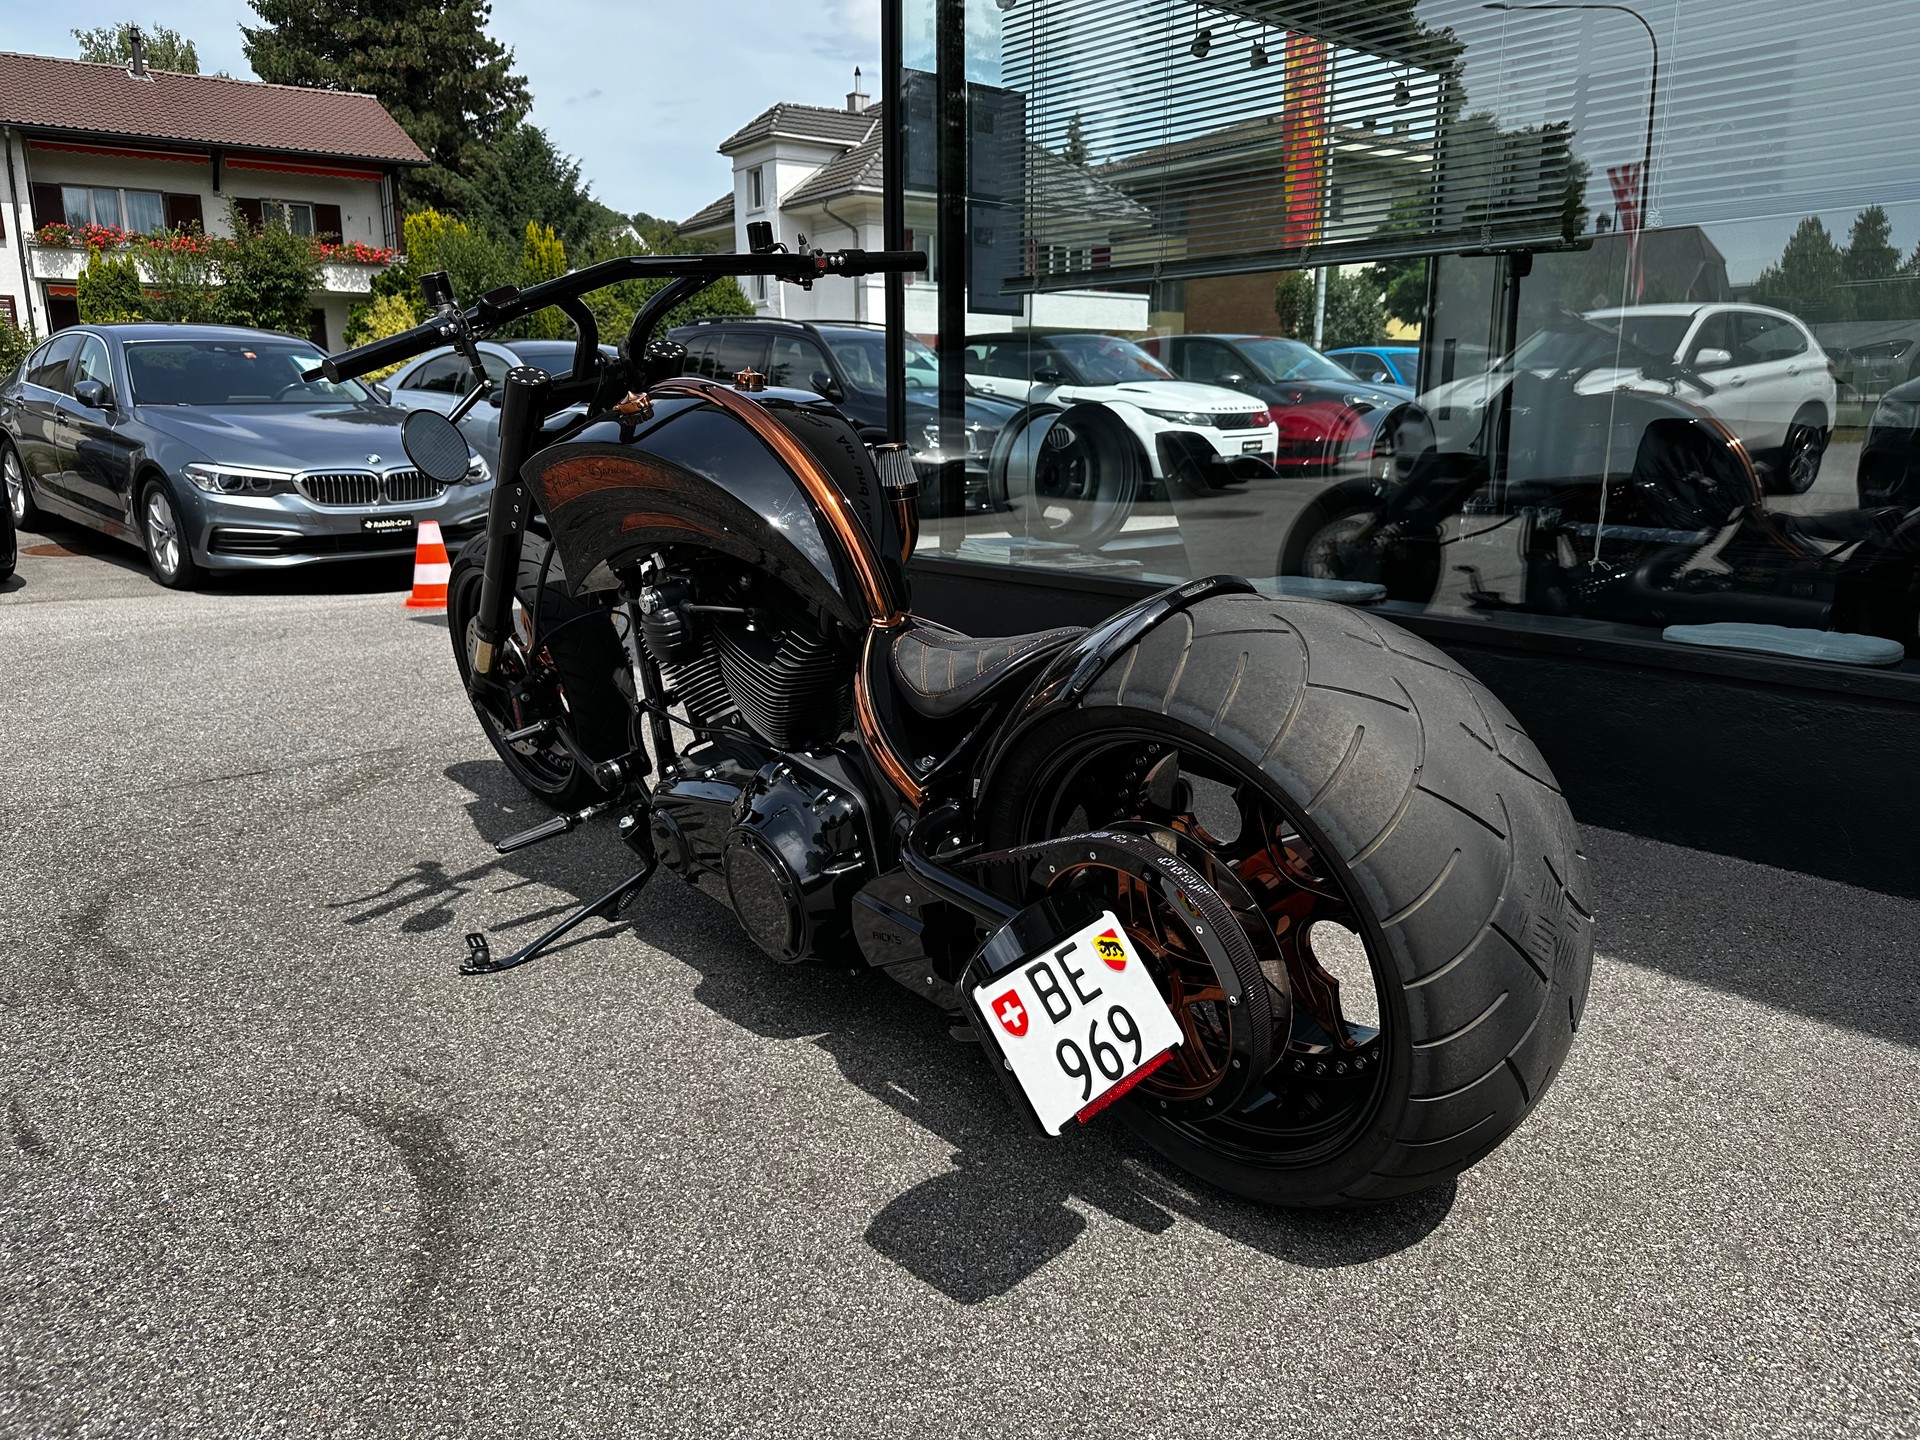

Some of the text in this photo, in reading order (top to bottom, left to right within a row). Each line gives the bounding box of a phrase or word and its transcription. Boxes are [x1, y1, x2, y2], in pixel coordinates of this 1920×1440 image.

[373, 519, 412, 528] Rabbit-Cars
[872, 931, 902, 945] RICK'S
[1025, 941, 1103, 1025] BE
[1056, 1004, 1142, 1101] 969
